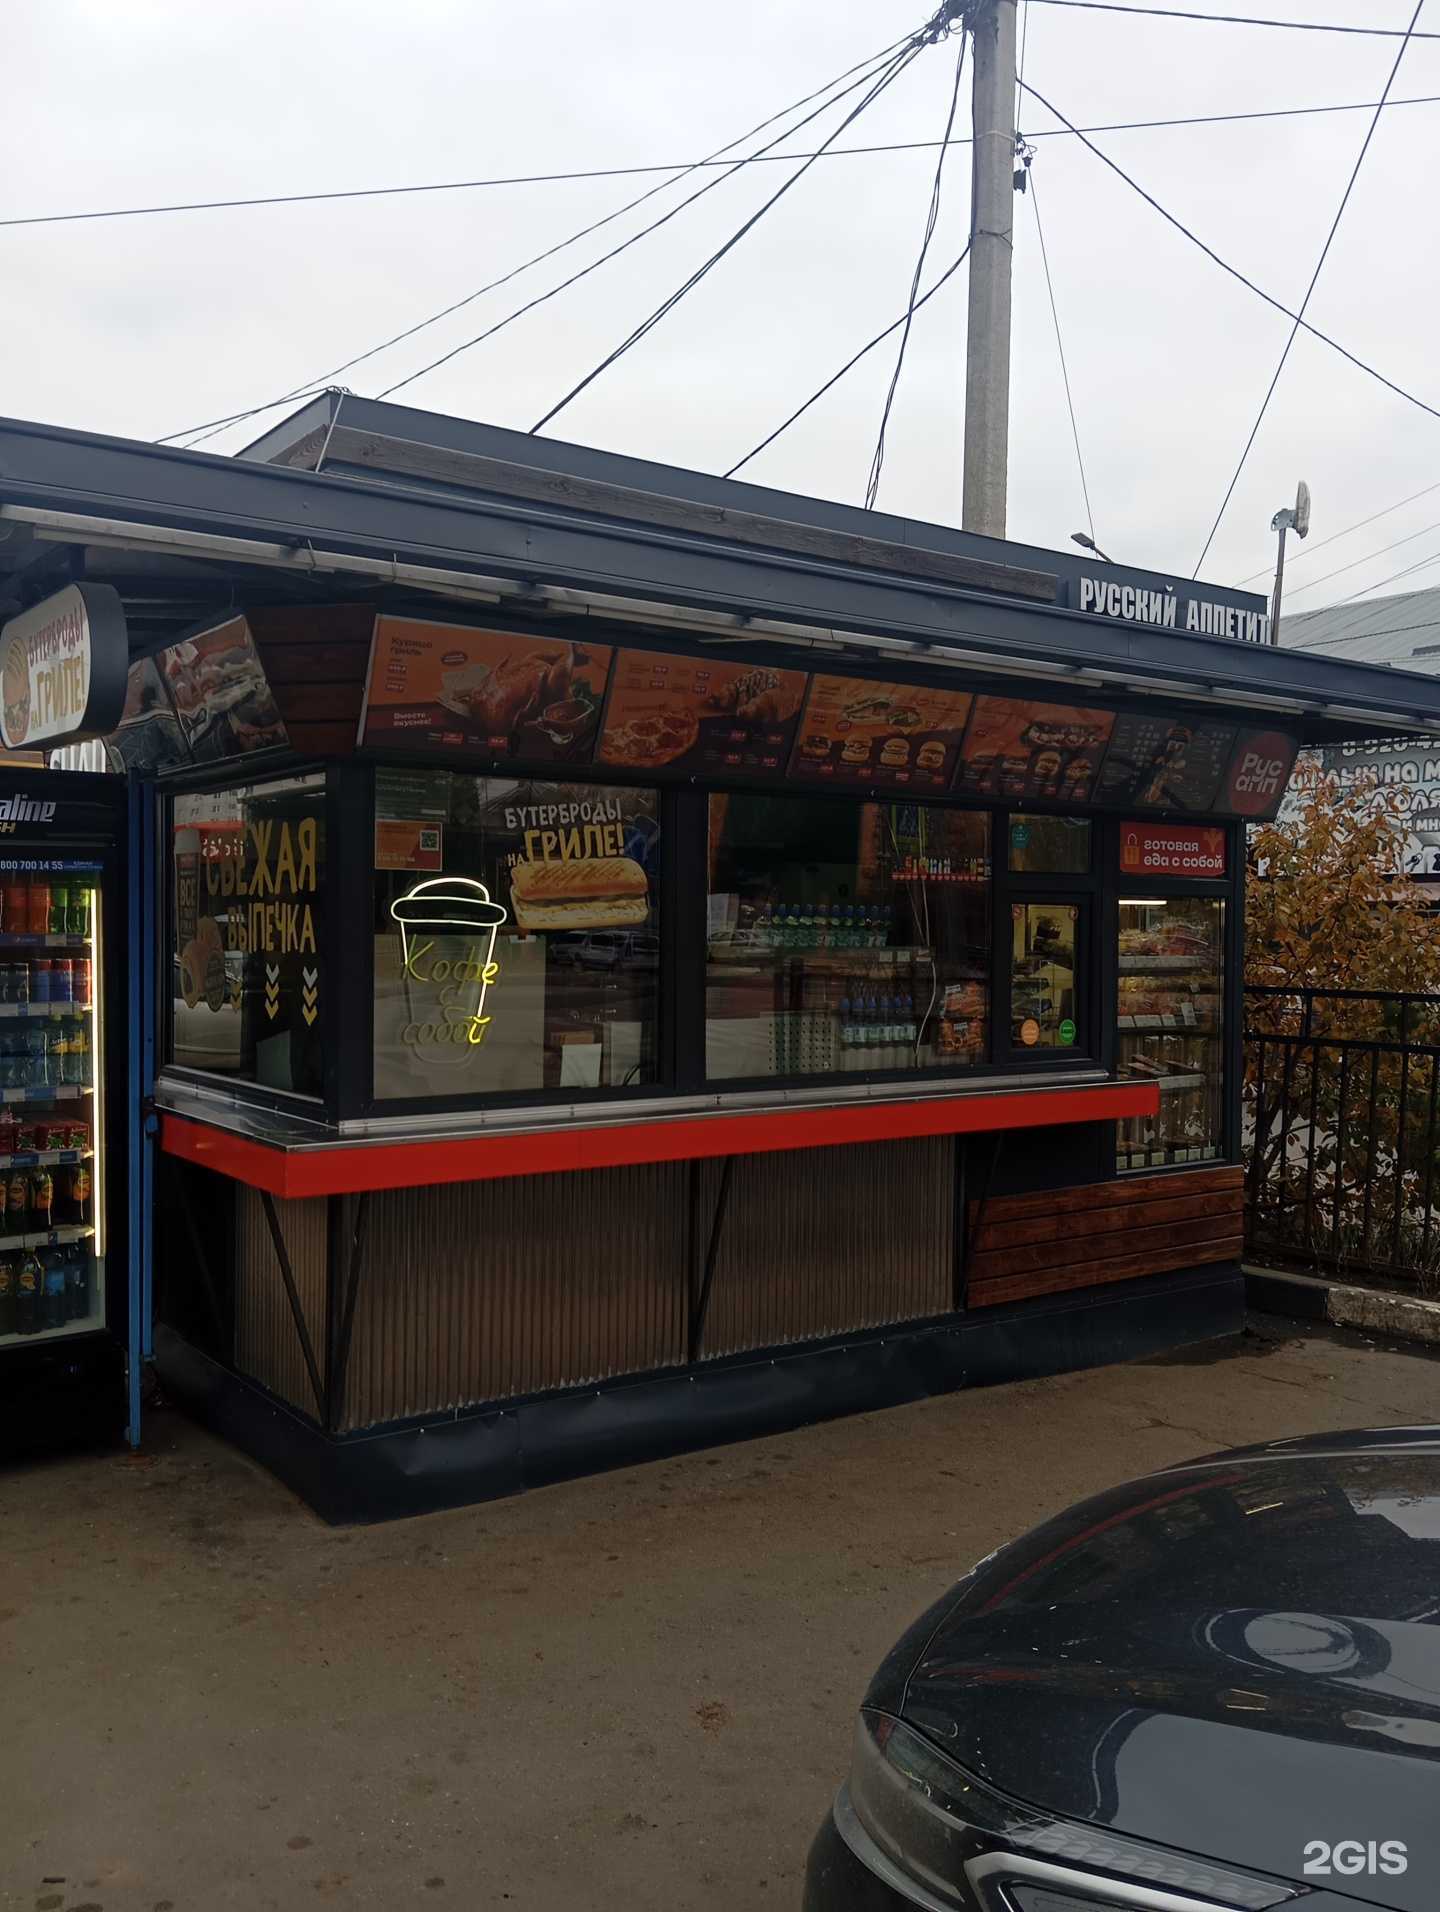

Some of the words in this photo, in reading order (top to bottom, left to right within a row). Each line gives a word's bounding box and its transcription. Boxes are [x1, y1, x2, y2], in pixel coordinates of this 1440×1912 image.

[1080, 577, 1177, 629] РУССКИЙ
[1186, 599, 1272, 645] АППЕТИТ
[1240, 753, 1284, 779] Рус
[504, 799, 622, 829] БУТЕРБРОДЫ
[523, 822, 626, 864] ГРИЛЕ!
[1143, 840, 1199, 852] готовая
[20, 860, 37, 870] 700
[38, 860, 50, 871] 14
[51, 860, 64, 870] 55
[1143, 853, 1169, 866] еда
[1172, 857, 1180, 867] с
[1183, 855, 1224, 869] собой
[226, 901, 318, 954] ВЫПЕЧКА
[402, 934, 499, 994] Кофе
